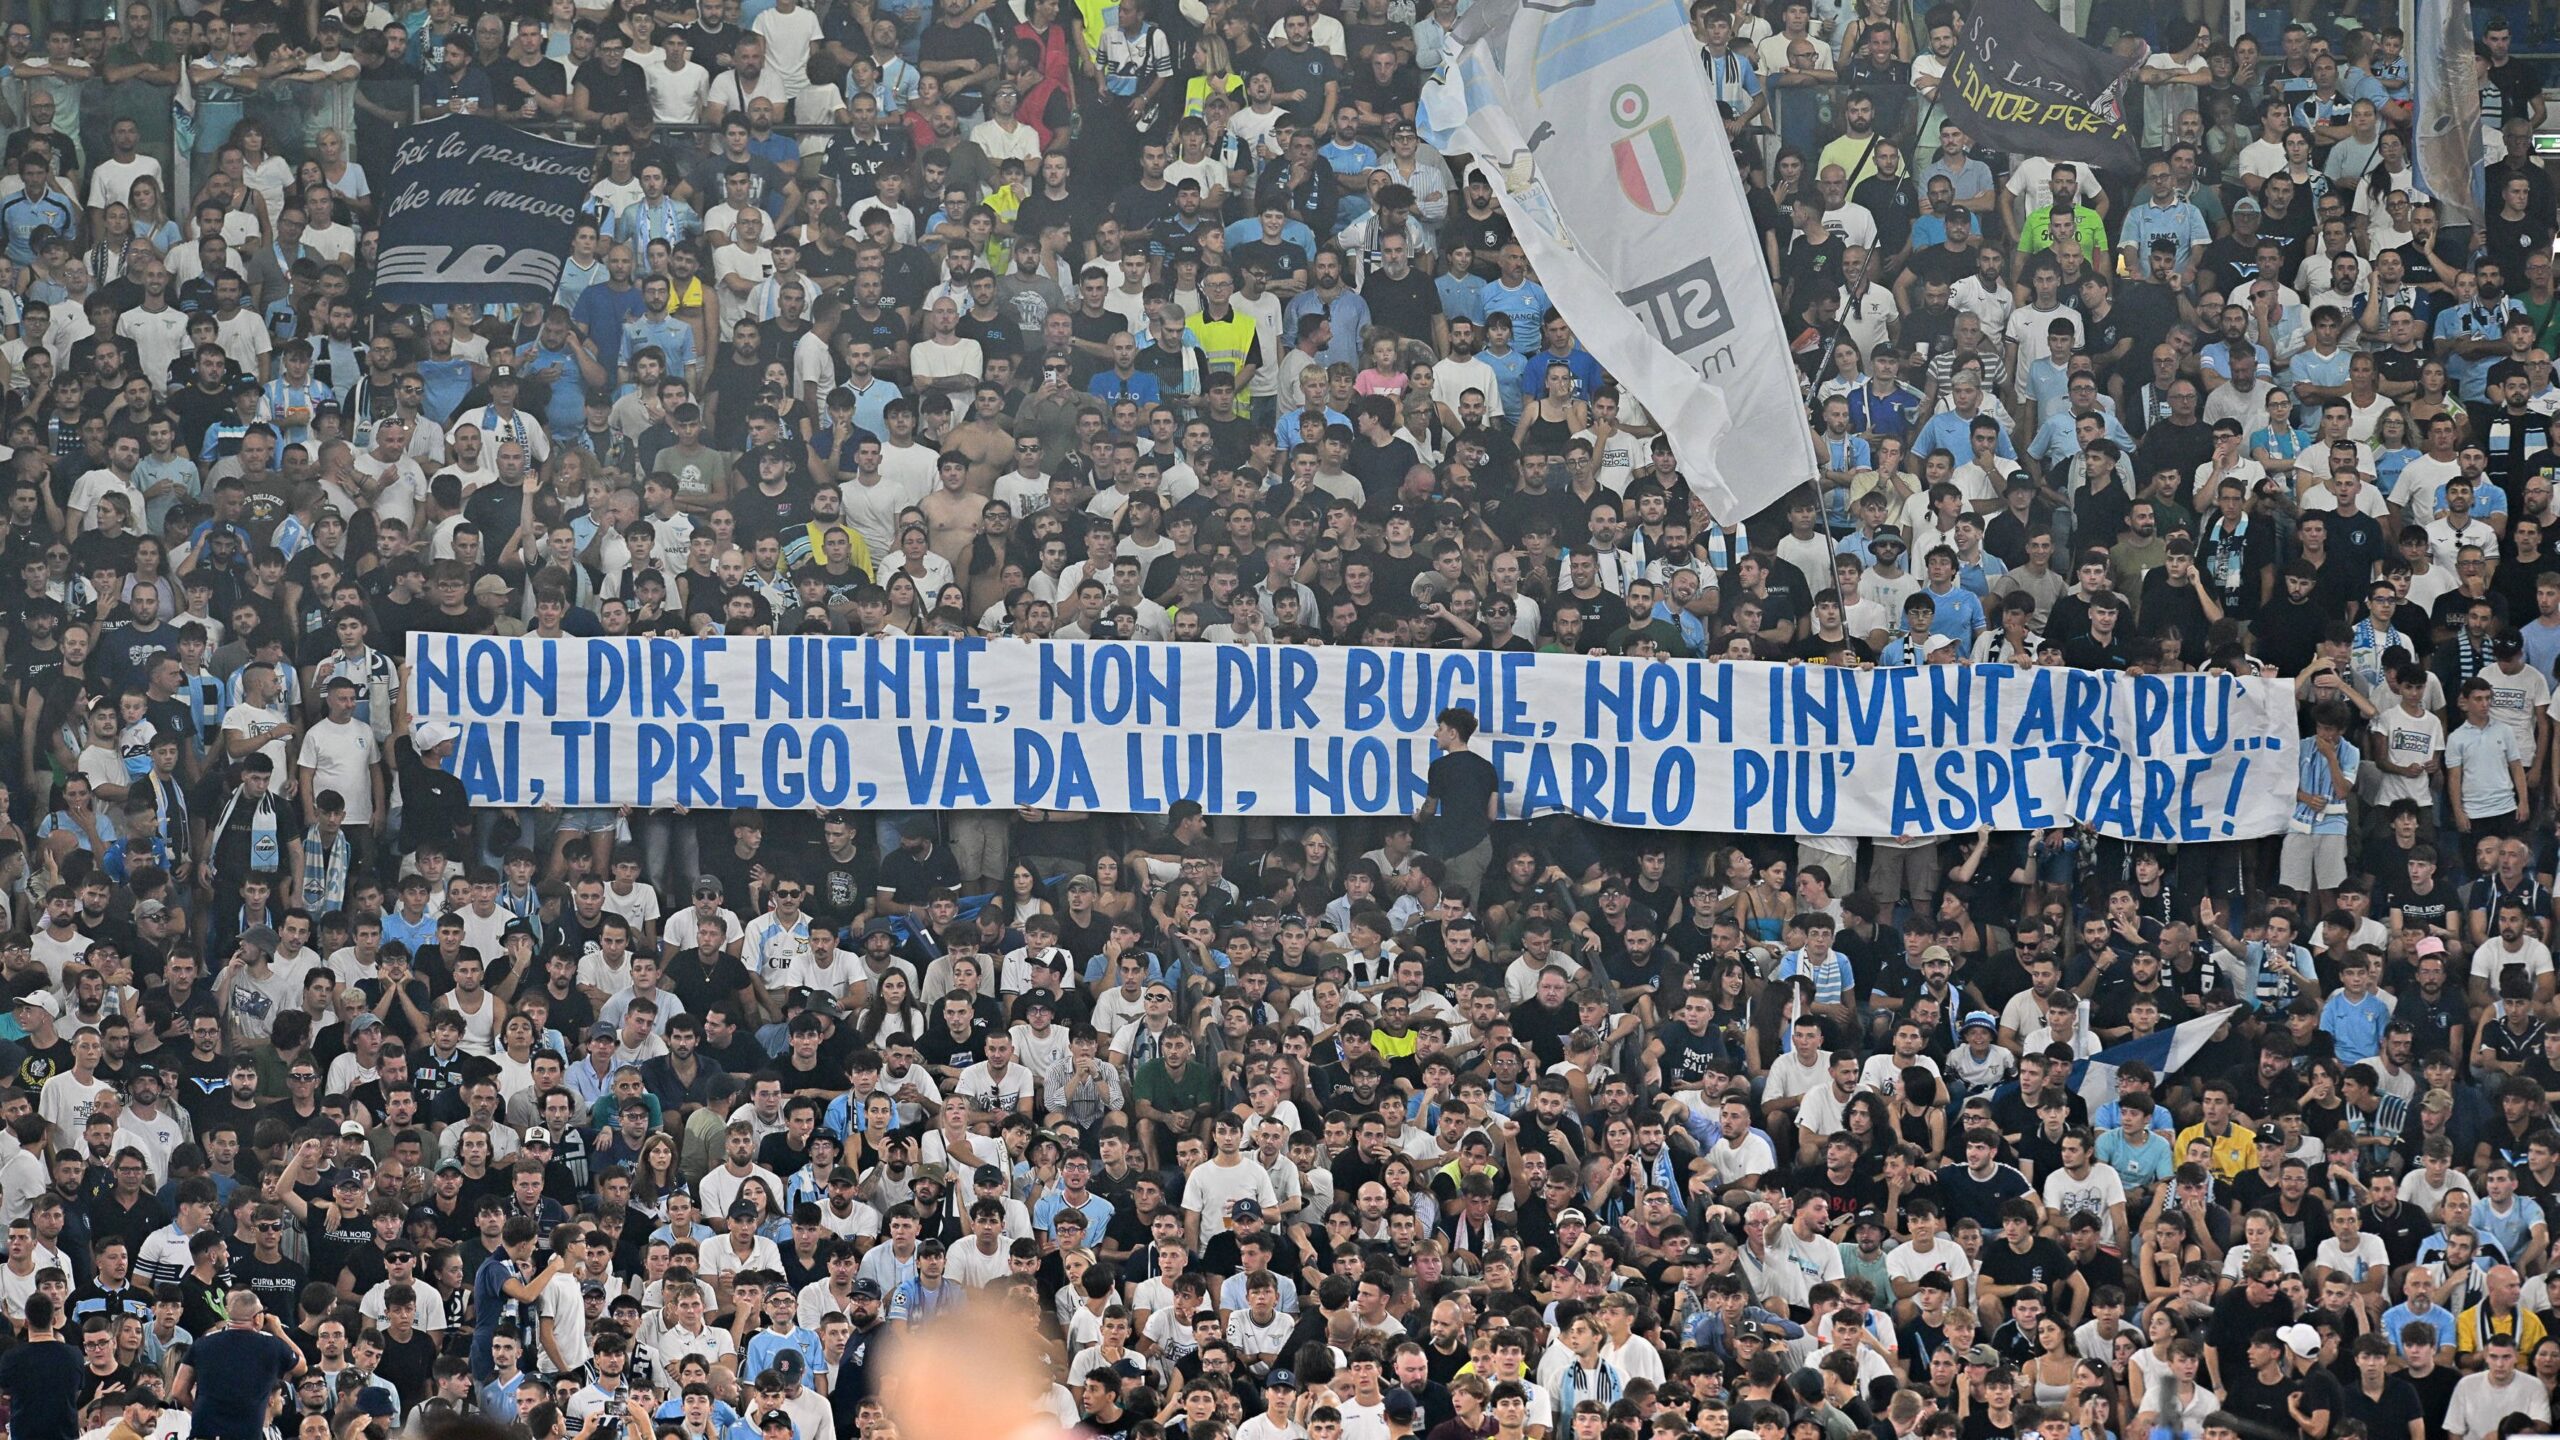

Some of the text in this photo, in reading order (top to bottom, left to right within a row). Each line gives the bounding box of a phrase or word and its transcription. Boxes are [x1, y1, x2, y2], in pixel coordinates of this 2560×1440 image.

[1951, 51, 2112, 134] L'AMOR PER
[391, 131, 592, 184] Sei la passione
[389, 181, 576, 225] che mi muove
[2150, 232, 2177, 241] BANCA
[872, 326, 892, 335] SSL
[986, 330, 1006, 340] SSL
[416, 634, 559, 718] NON
[586, 638, 728, 722] DIRE
[754, 640, 1010, 724] NIENTE,
[1040, 645, 1182, 728] NON
[1215, 649, 1320, 730] DIR
[1344, 653, 1557, 739] BUGIE,
[1583, 659, 1734, 745] NON
[637, 721, 878, 809] PREGO,
[897, 725, 992, 807] VA
[1013, 727, 1101, 811] DA
[1126, 732, 1257, 815] LUI,
[1294, 735, 1444, 816] NON
[1491, 740, 1696, 827] FARLO
[1732, 747, 1856, 835] PIU'
[768, 957, 791, 969] CIR
[1683, 1047, 1714, 1063] NORTH
[1682, 1058, 1709, 1074] SAL
[351, 1169, 362, 1181] 12
[349, 1230, 372, 1239] NORD
[251, 1277, 297, 1287] CURVA NORD
